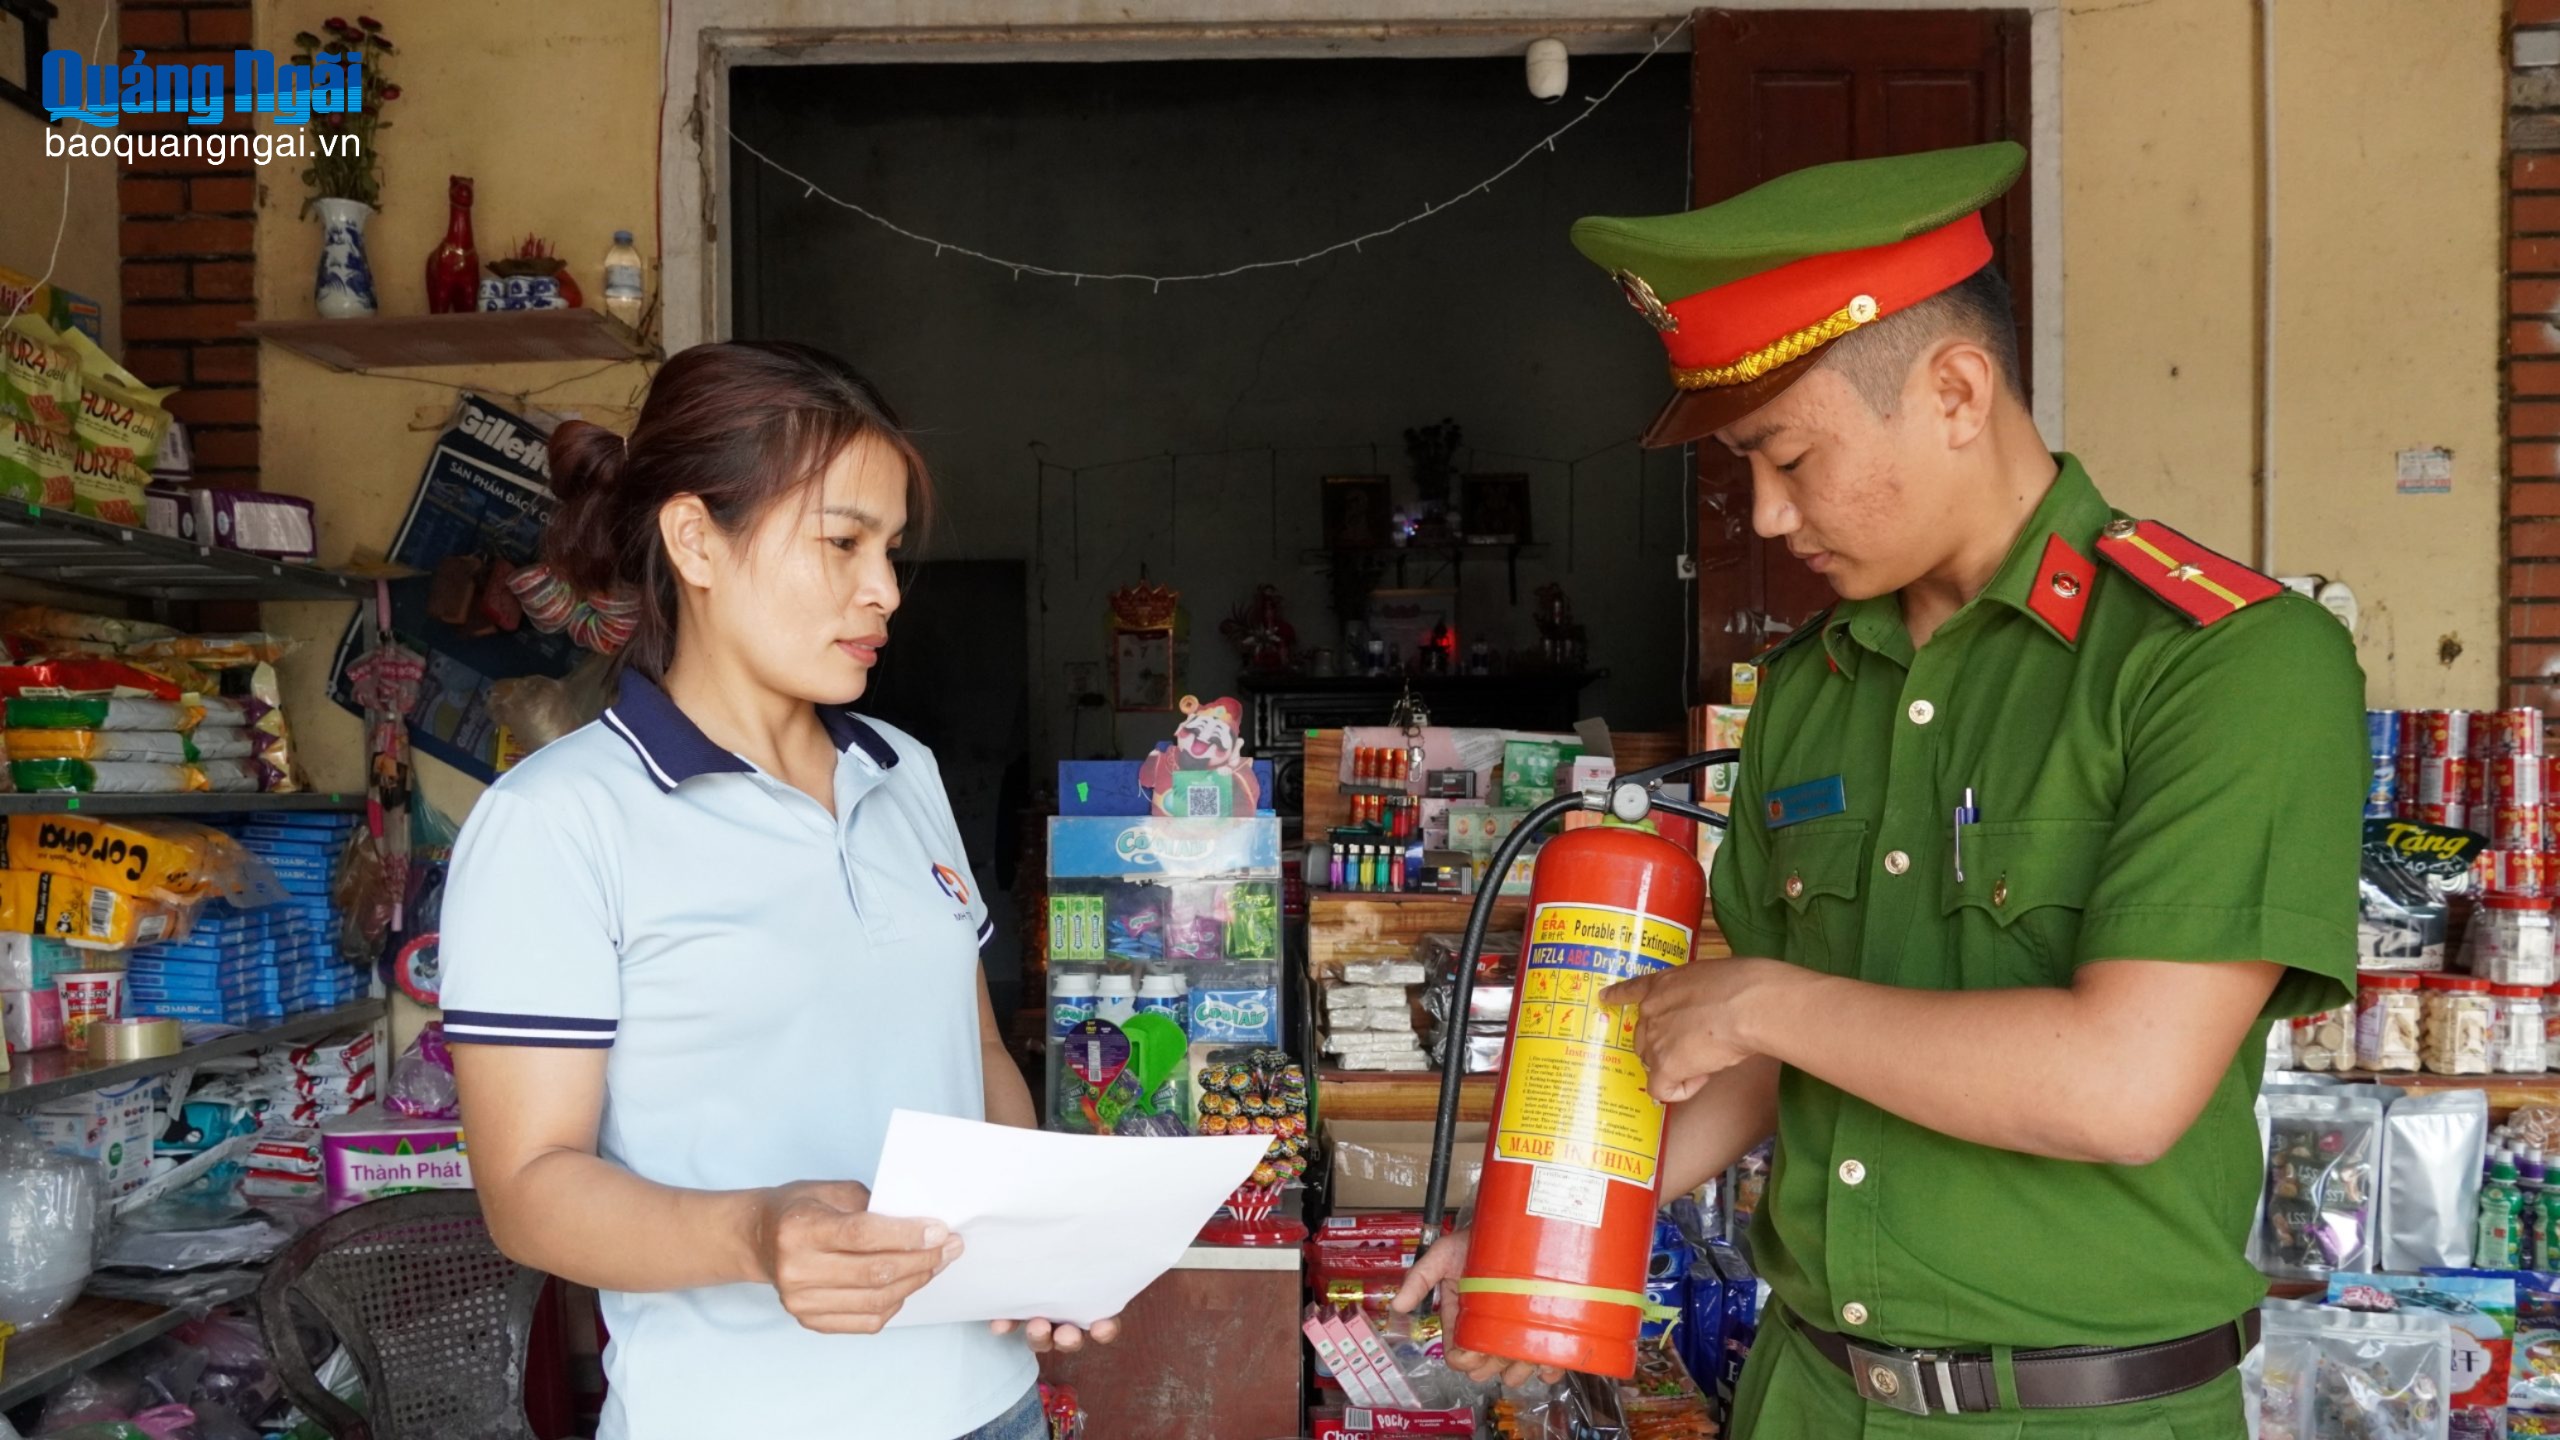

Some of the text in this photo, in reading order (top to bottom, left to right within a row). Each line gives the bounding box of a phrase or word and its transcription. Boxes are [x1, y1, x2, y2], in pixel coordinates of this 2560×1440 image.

[80, 386, 133, 429] HURA
[2386, 822, 2470, 860] Tặng
[1541, 918, 1567, 931] ERA
[1574, 919, 1616, 942] Portable
[1640, 929, 1687, 961] Extinguisher
[1532, 948, 1565, 965] MFZL4
[1566, 951, 1591, 967] ABC
[1592, 951, 1616, 973] Dry
[351, 1161, 462, 1181] Thành Phát
[1508, 1136, 1642, 1176] MADE IN CHINA
